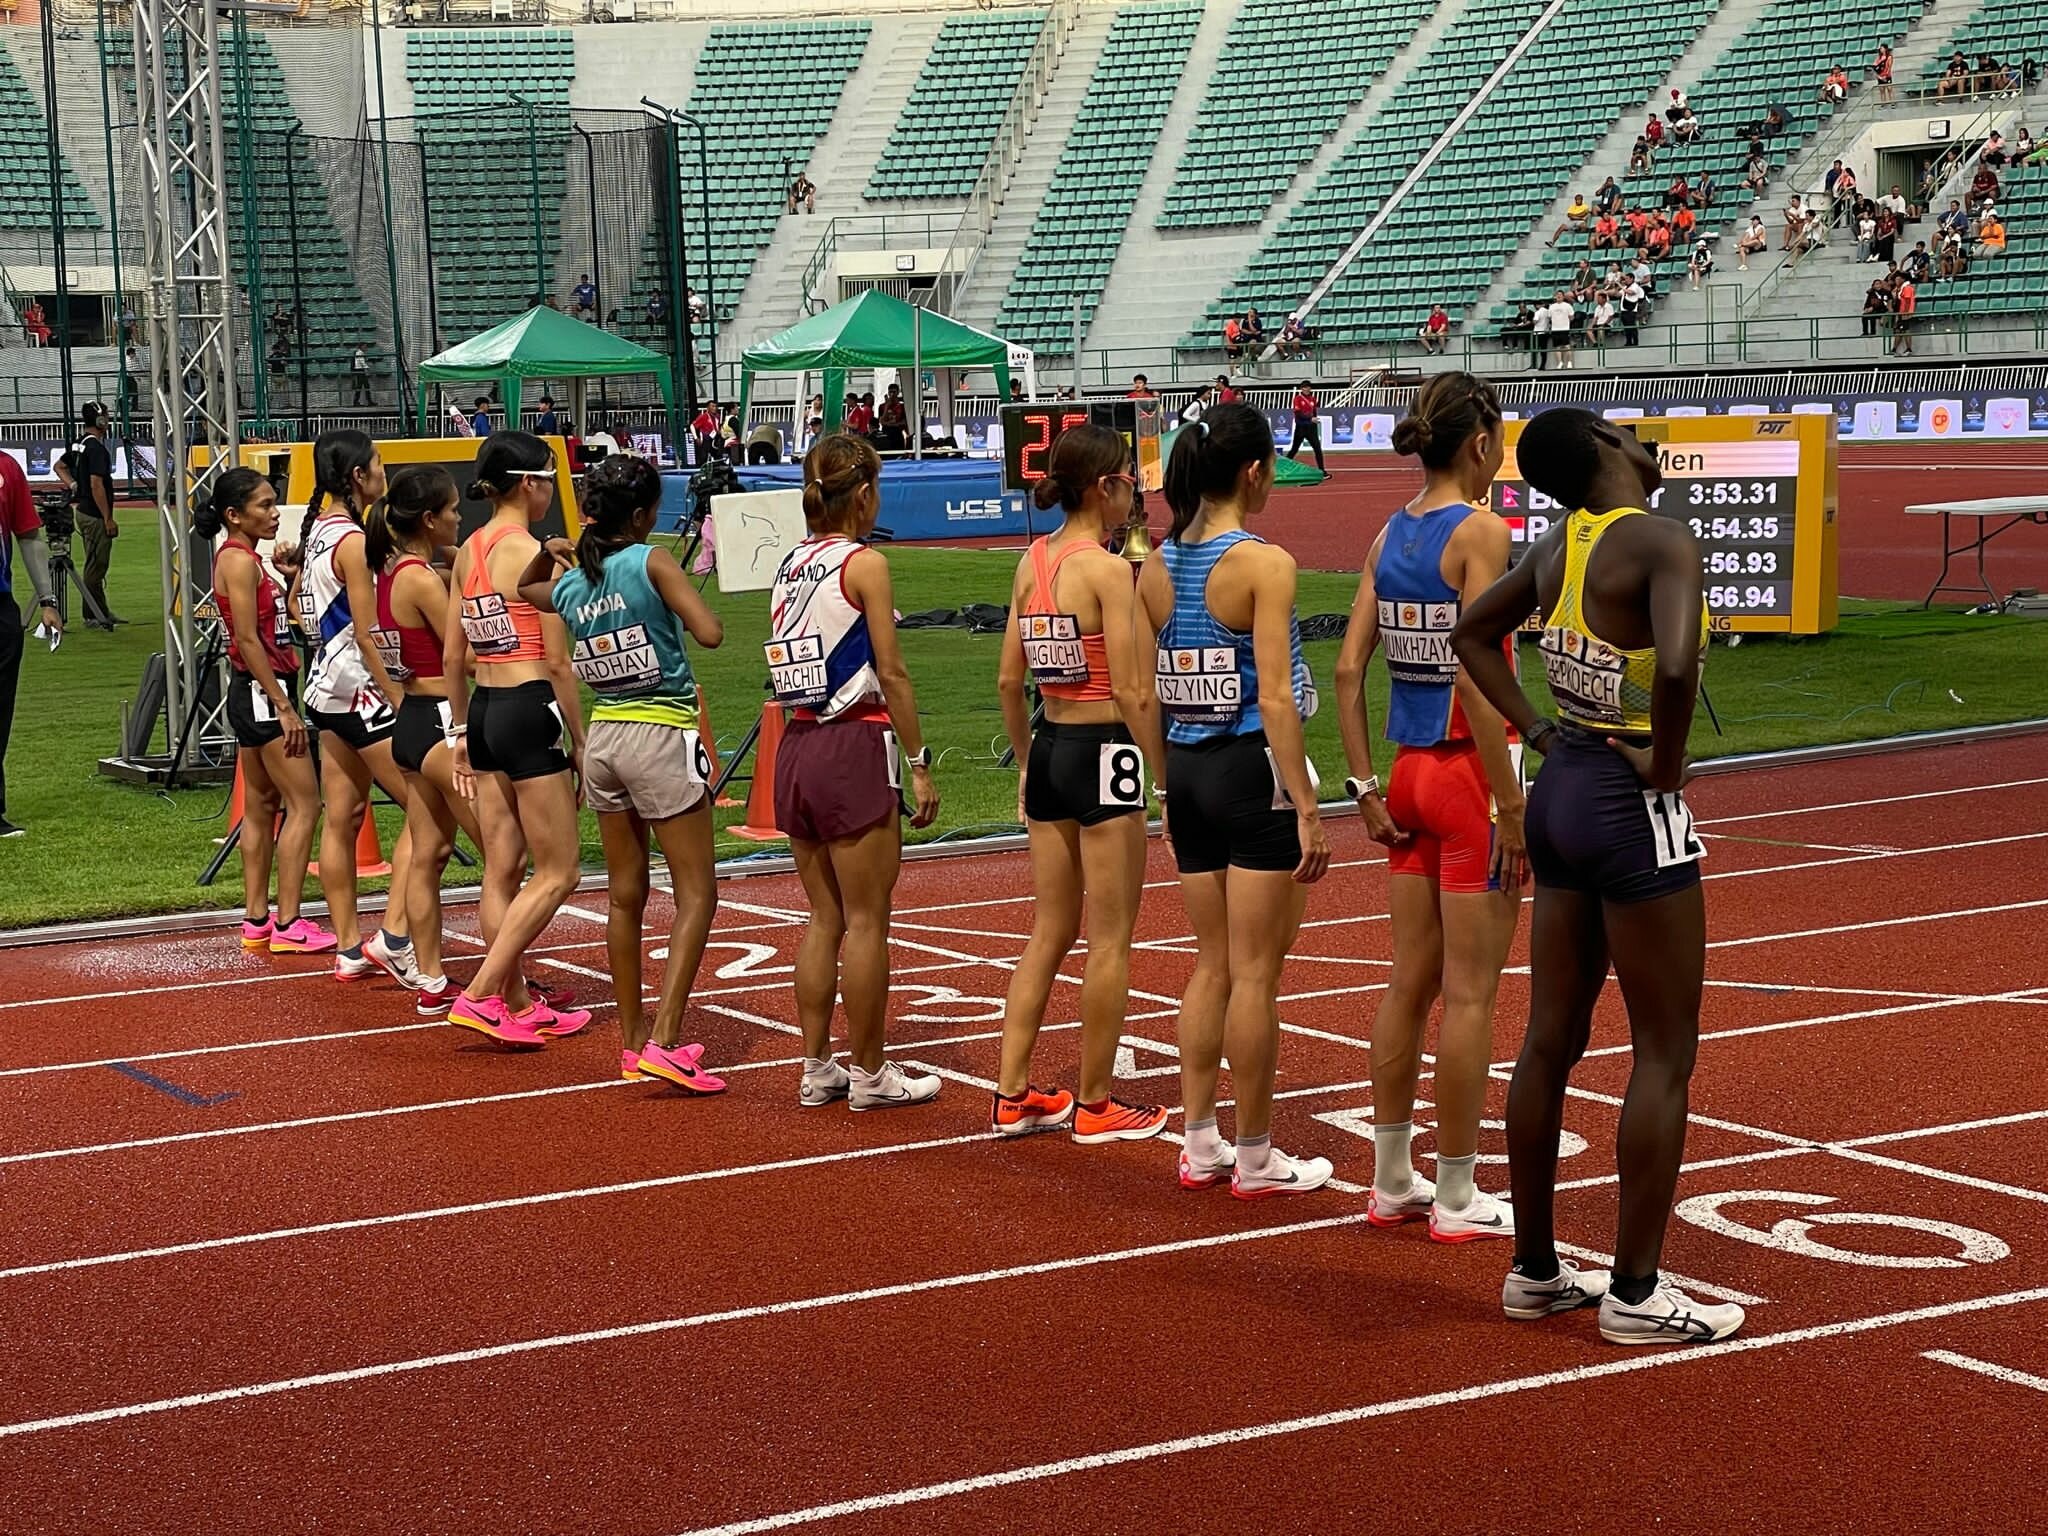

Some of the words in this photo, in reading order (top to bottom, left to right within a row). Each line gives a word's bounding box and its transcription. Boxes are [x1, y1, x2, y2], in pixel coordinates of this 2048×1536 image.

[1688, 482, 1777, 504] 3:53.31
[946, 499, 1003, 515] UCS
[1688, 516, 1779, 539] 3:54.35
[1702, 552, 1777, 574] :56.93
[576, 592, 627, 625] INDIA
[480, 616, 513, 640] KOKAI
[1027, 644, 1082, 666] AGUCHI
[1158, 678, 1182, 701] TSZ
[1186, 677, 1237, 701] YING
[1110, 749, 1141, 802] 8
[1653, 792, 1702, 859] 12
[1675, 1190, 2012, 1269] 6
